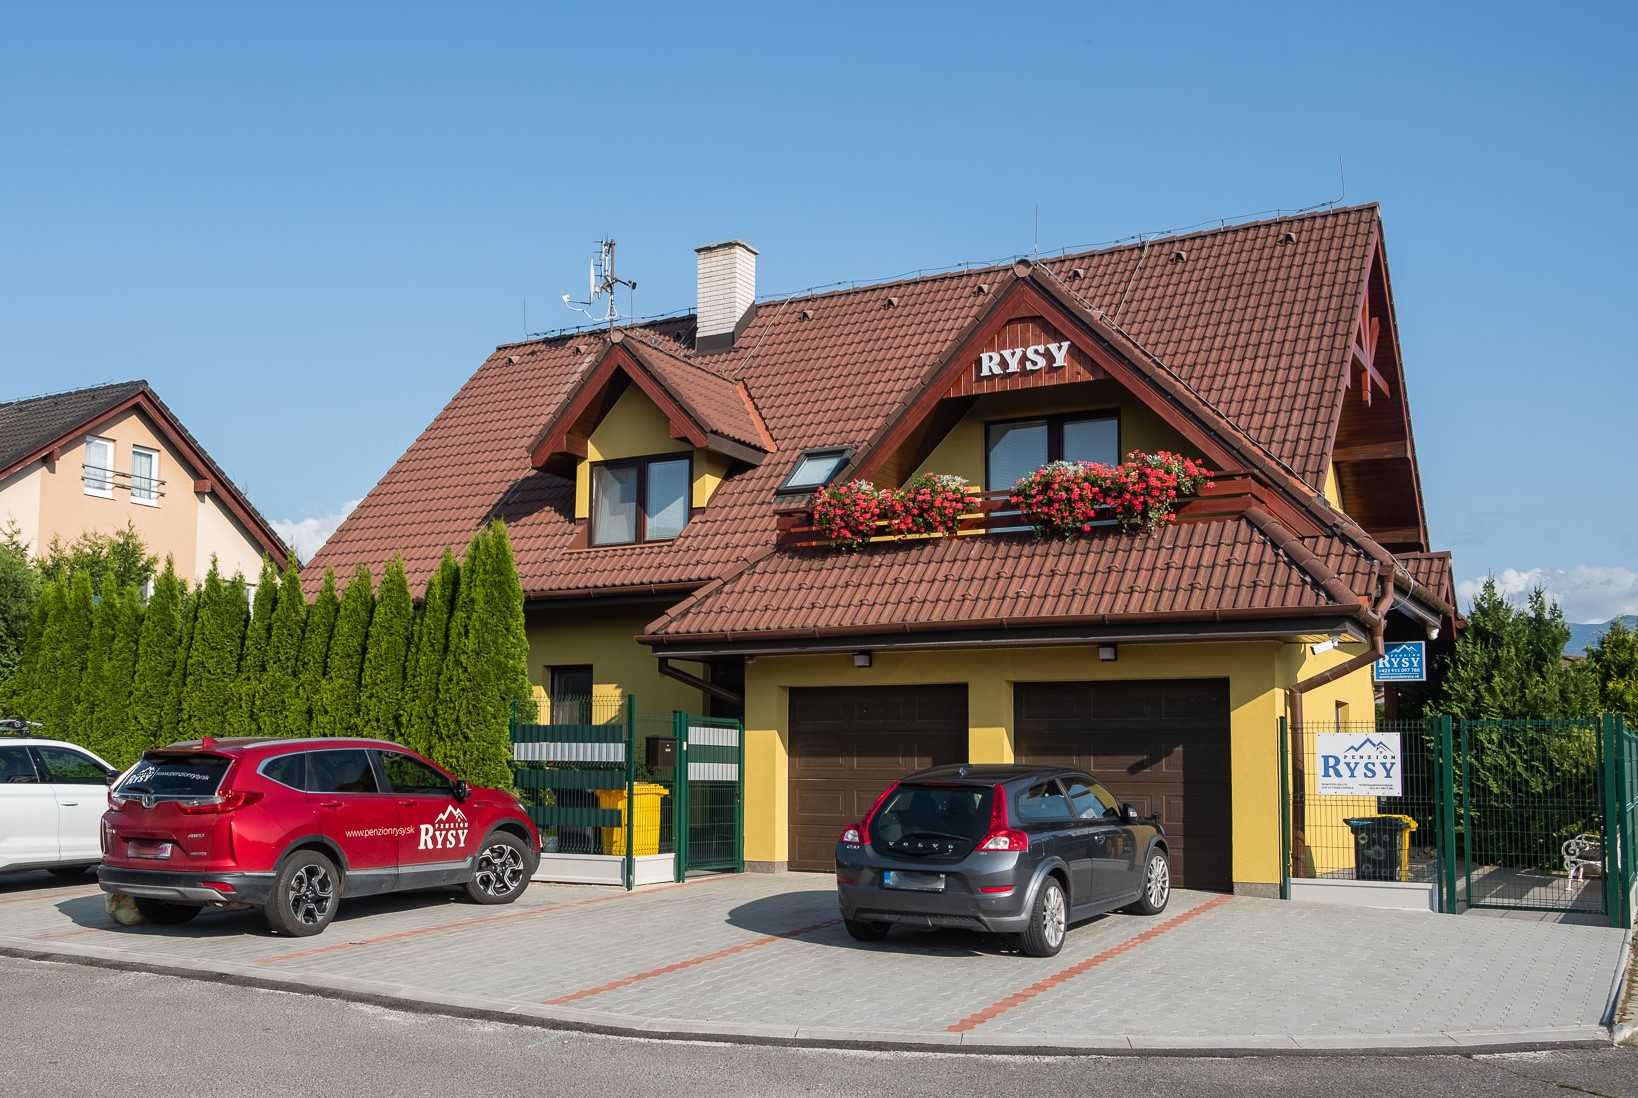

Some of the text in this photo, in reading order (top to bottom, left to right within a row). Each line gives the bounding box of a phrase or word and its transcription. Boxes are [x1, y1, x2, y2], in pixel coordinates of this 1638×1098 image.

[980, 341, 1071, 376] RYSY
[1378, 654, 1420, 668] RYSY
[1321, 754, 1396, 778] RYSY
[418, 824, 468, 849] RYSY
